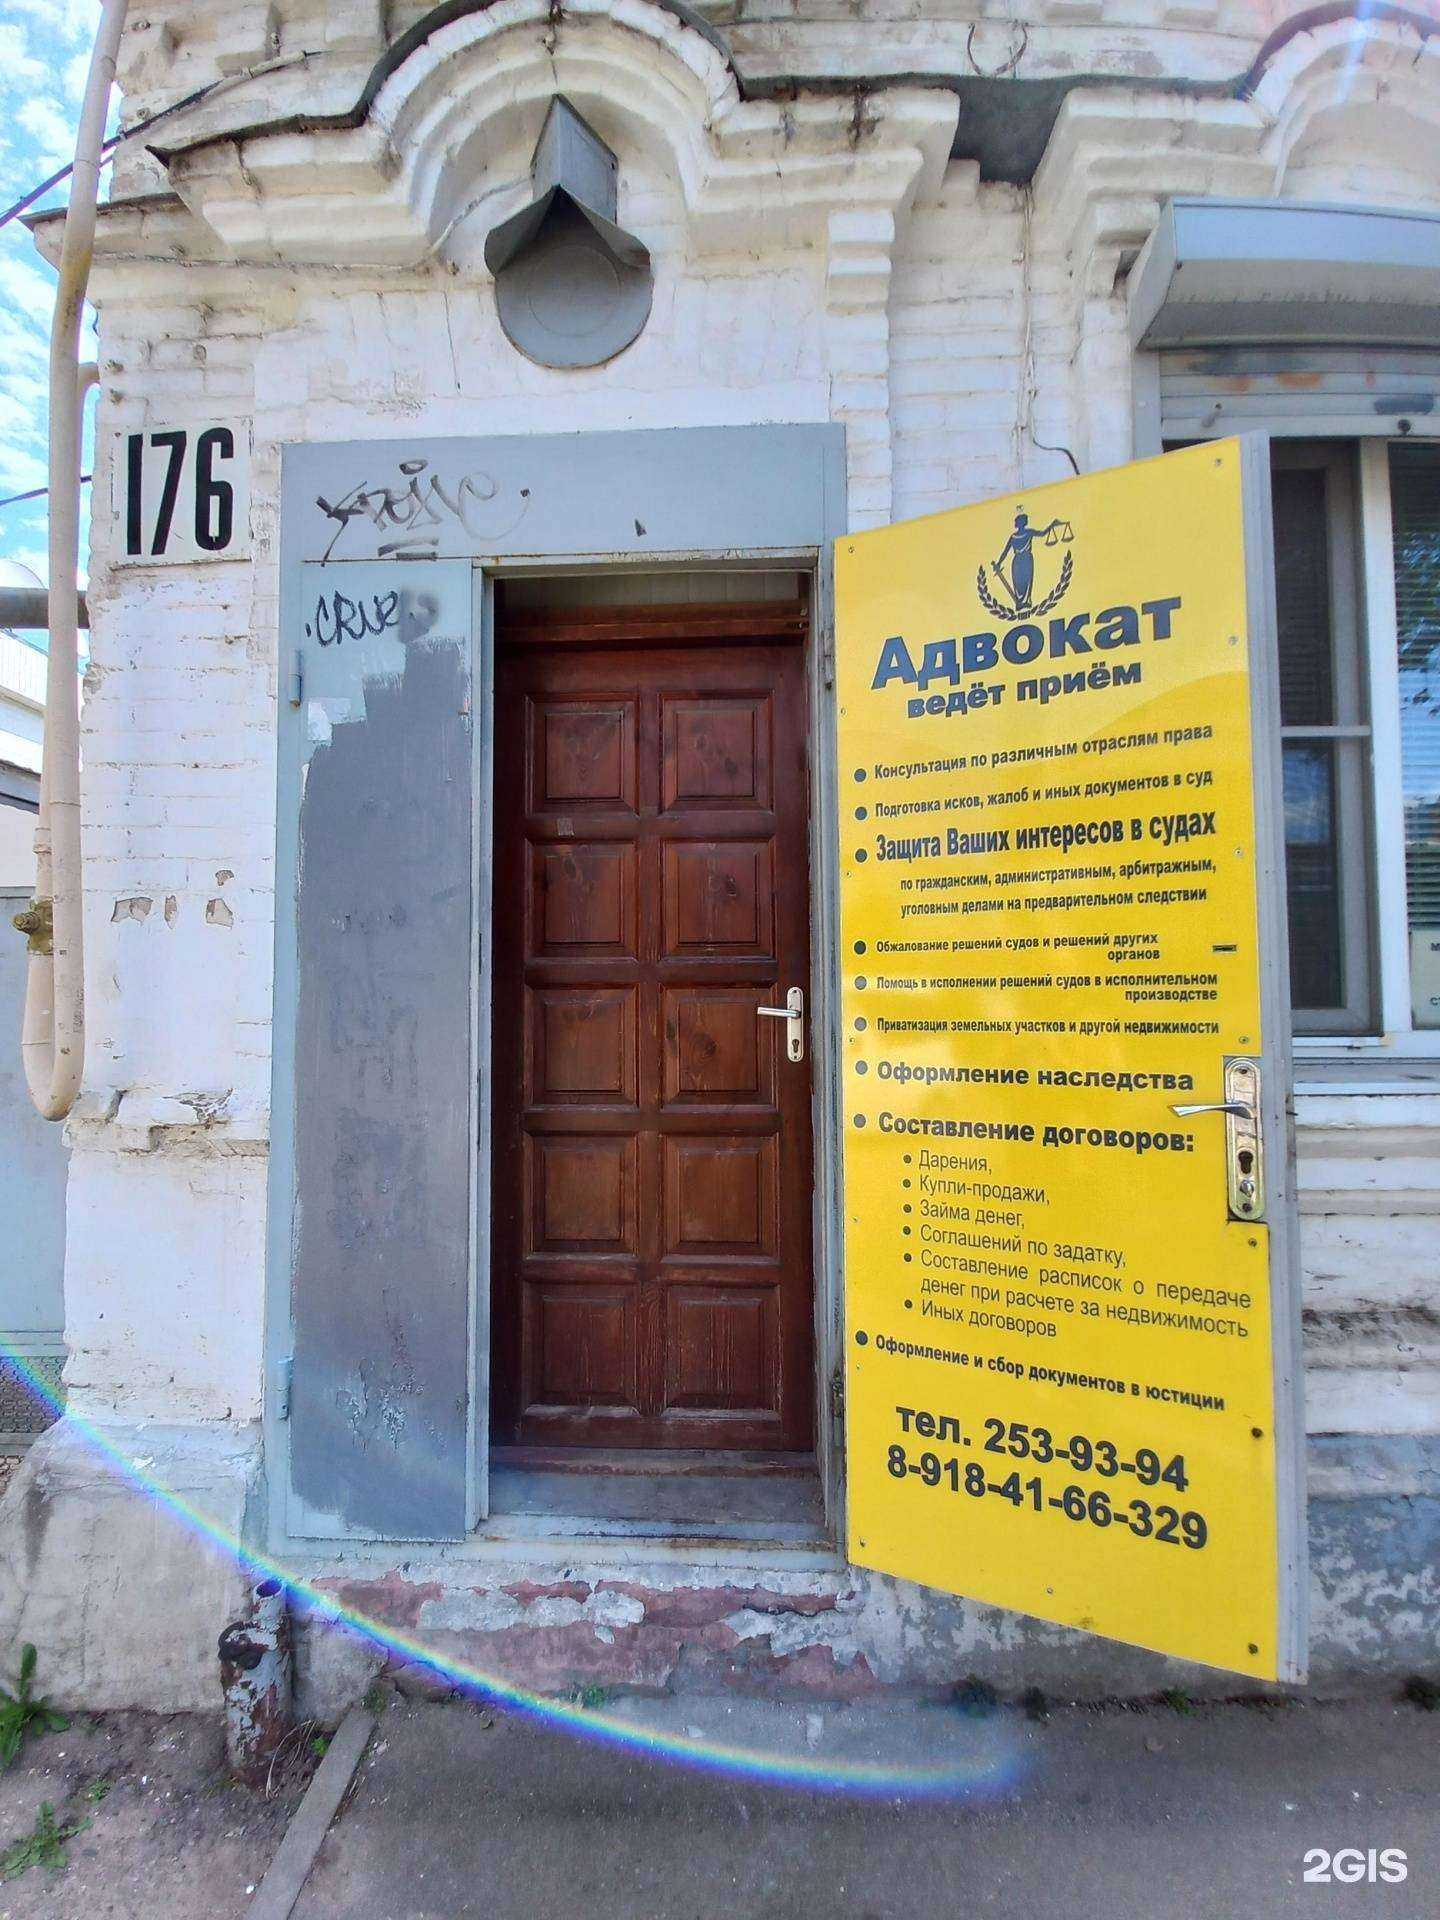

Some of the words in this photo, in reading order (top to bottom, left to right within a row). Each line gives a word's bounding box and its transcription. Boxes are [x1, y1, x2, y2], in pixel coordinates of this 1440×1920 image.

[126, 426, 235, 556] 176
[871, 596, 1182, 691] Адвокат
[907, 682, 1005, 719] ведёт
[1017, 660, 1142, 704] приём
[875, 758, 966, 779] Консультация
[971, 756, 987, 767] по
[992, 743, 1077, 768] различным
[1082, 732, 1158, 755] отраслям
[1164, 725, 1213, 745] права
[876, 800, 941, 818] Подготовка
[945, 796, 983, 810] исков,
[987, 787, 1028, 805] жалоб
[1033, 789, 1041, 800] и
[1045, 785, 1080, 799] иных
[1085, 775, 1169, 797] документов
[1174, 774, 1181, 785] в
[1186, 770, 1213, 788] суд
[876, 834, 941, 863] Защита
[947, 828, 1010, 855] Ваших
[1016, 820, 1124, 853] интересов
[1131, 818, 1143, 840] в
[1150, 811, 1216, 846] судах
[901, 879, 913, 890] по
[915, 873, 991, 892] гражданским,
[995, 865, 1115, 887] административным,
[1119, 859, 1216, 879] арбитражным,
[901, 901, 958, 918] уголовным
[962, 899, 1003, 914] делами
[1007, 898, 1020, 910] на
[1024, 891, 1133, 912] предварительном
[1137, 888, 1207, 905] следствии
[877, 937, 948, 953] Обжалование
[952, 937, 1002, 952] решений
[1006, 935, 1039, 950] судов
[1043, 937, 1050, 947] и
[1054, 933, 1109, 949] решений
[1113, 933, 1158, 947] других
[1107, 950, 1160, 963] органов
[877, 976, 918, 989] Помощь
[921, 978, 926, 988] в
[930, 976, 996, 988] исполнении
[1000, 974, 1052, 989] решений
[1056, 974, 1090, 989] судов
[1094, 975, 1101, 985] в
[1105, 973, 1218, 986] исполнительном
[1125, 989, 1217, 1003] производстве
[877, 1018, 947, 1033] Приватизация
[951, 1020, 1011, 1032] земельных
[1015, 1020, 1065, 1035] участков
[1069, 1022, 1076, 1032] и
[1080, 1018, 1120, 1036] другой
[1124, 1021, 1219, 1035] недвижимости
[877, 1061, 1029, 1084] Оформление
[1038, 1070, 1193, 1092] наследства
[879, 1112, 1035, 1141] Составление
[1042, 1126, 1194, 1154] договоров:
[919, 1150, 992, 1175] Дарения,
[919, 1174, 1050, 1205] Купли-продажи,
[920, 1199, 970, 1221] Займа
[975, 1208, 1025, 1229] денег,
[920, 1224, 1021, 1252] Соглашений
[1028, 1239, 1048, 1255] по
[1053, 1242, 1126, 1267] задатку,
[921, 1249, 1029, 1279] Составление
[1040, 1268, 1122, 1291] расписок
[1133, 1280, 1144, 1294] о
[1157, 1282, 1251, 1308] передаче
[921, 1278, 965, 1296] денег
[971, 1284, 1000, 1302] при
[1006, 1289, 1074, 1313] расчете
[1080, 1301, 1100, 1317] за
[1106, 1303, 1248, 1337] недвижимость
[921, 1299, 964, 1322] Иных
[969, 1310, 1057, 1337] договоров
[876, 1334, 969, 1365] Оформление
[974, 1354, 983, 1368] и
[988, 1356, 1024, 1378] сбор
[1029, 1362, 1125, 1394] документов
[1131, 1382, 1140, 1396] в
[1146, 1385, 1225, 1411] юстиции
[896, 1406, 971, 1446] тел.
[984, 1418, 1189, 1492] 253-93-94
[887, 1444, 1208, 1550] 8-918-41-66-329
